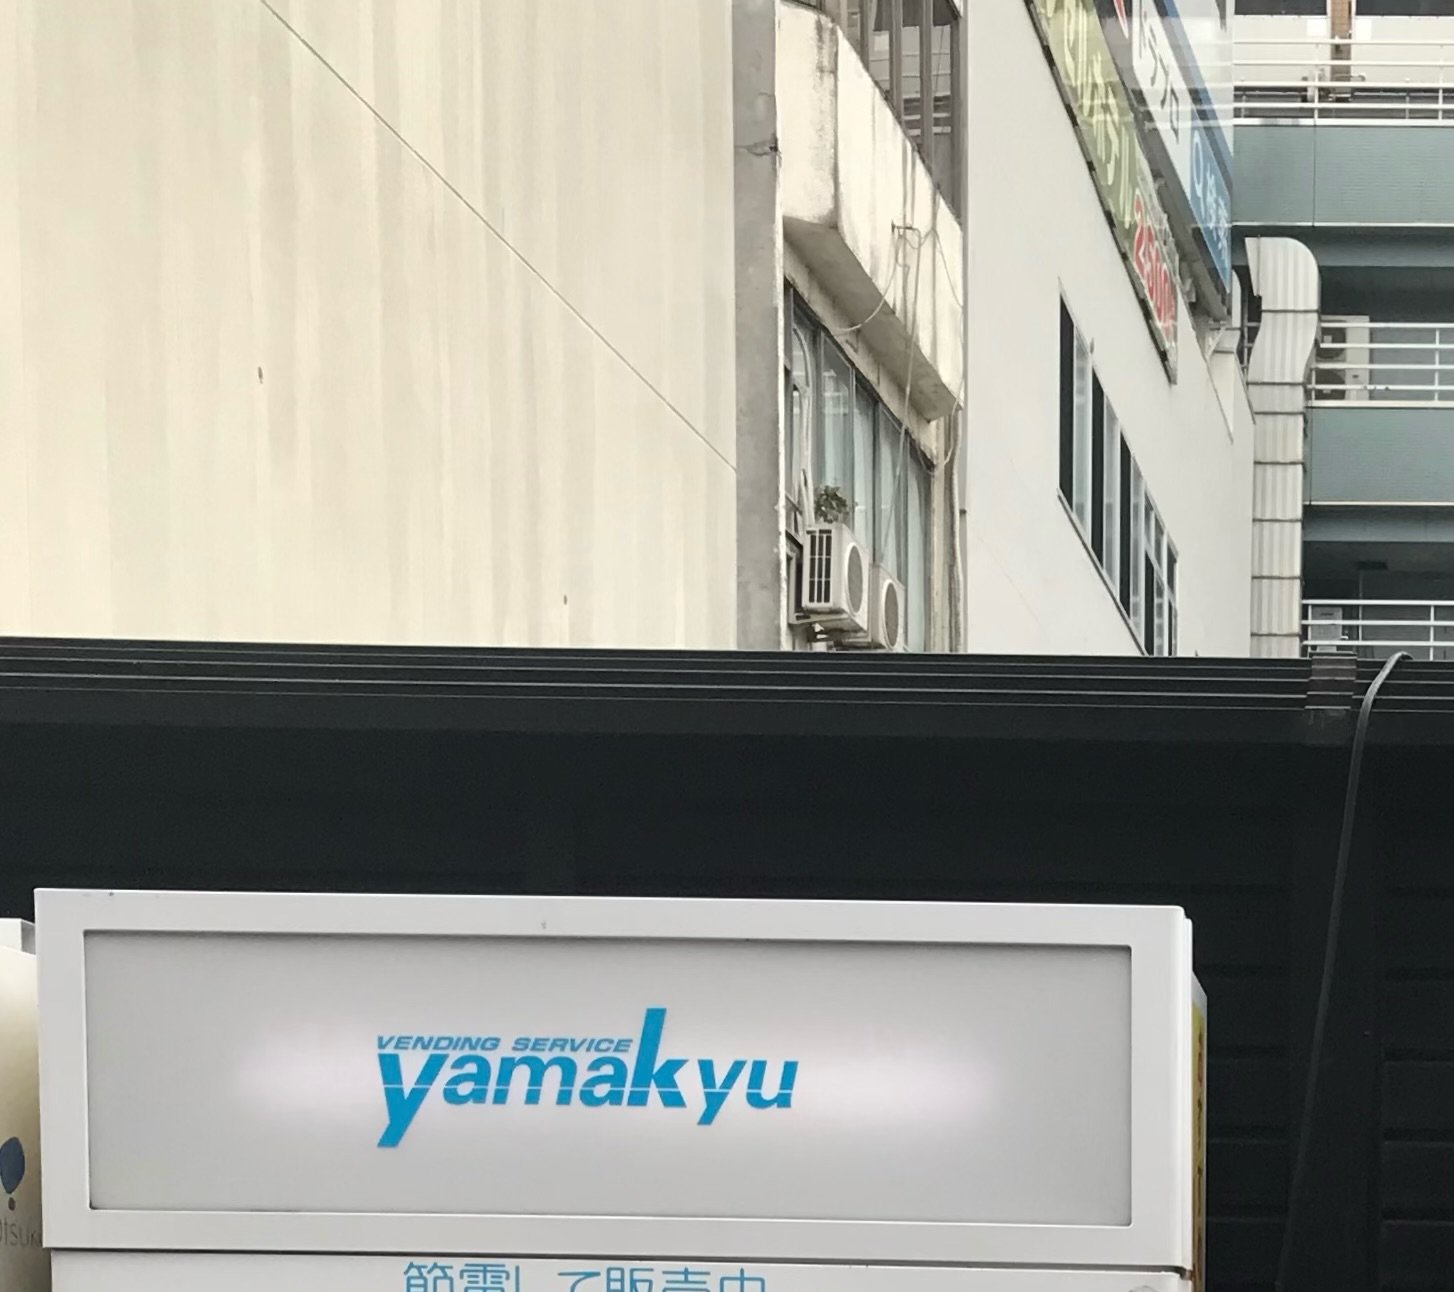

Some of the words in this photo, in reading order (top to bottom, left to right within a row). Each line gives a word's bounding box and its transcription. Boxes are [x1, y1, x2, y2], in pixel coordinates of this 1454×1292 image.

[376, 1035, 501, 1052] VENDING
[511, 1036, 633, 1054] SERVICE
[376, 1007, 799, 1149] yamakyu
